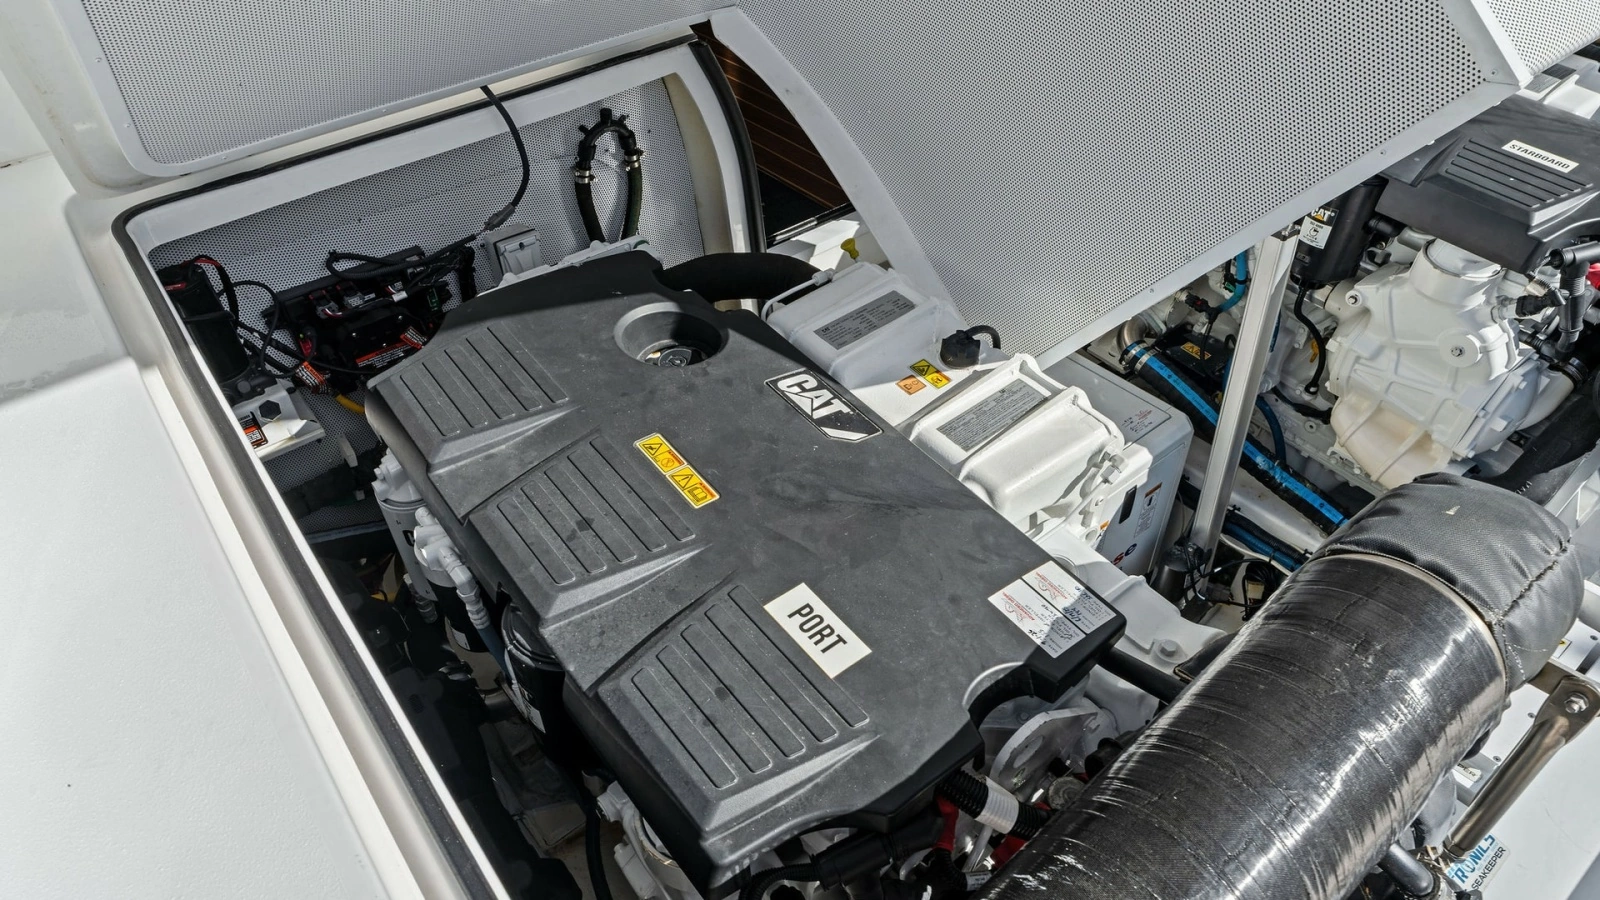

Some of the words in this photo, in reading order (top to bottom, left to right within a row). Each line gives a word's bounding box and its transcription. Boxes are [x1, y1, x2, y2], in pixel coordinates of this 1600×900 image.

[1509, 143, 1571, 169] STARBOARD
[777, 374, 853, 420] CAT
[787, 602, 848, 654] PORT
[1471, 846, 1507, 890] SEAKEEPER
